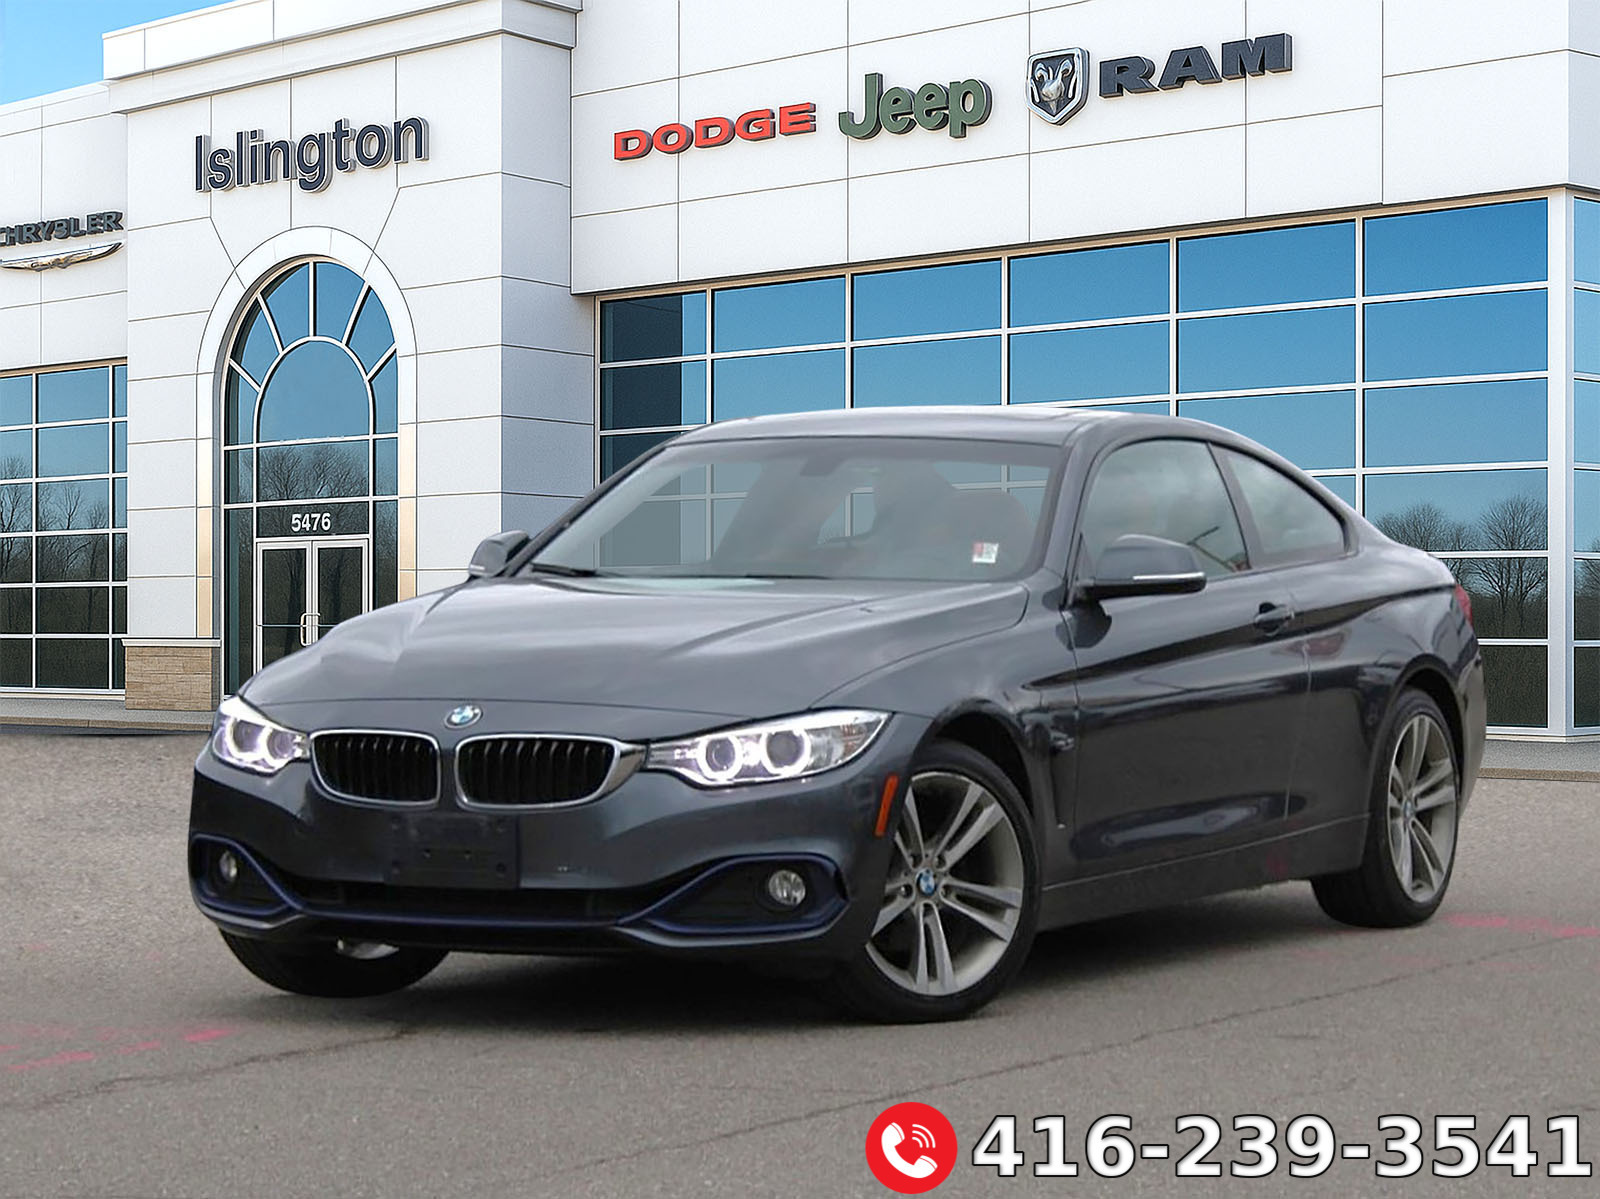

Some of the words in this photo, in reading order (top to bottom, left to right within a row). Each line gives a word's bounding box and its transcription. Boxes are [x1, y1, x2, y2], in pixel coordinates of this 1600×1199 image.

[1100, 33, 1293, 97] RAM
[614, 102, 817, 161] DODGE
[839, 73, 992, 139] Jeep
[195, 116, 429, 192] Islington
[291, 512, 331, 532] 5476
